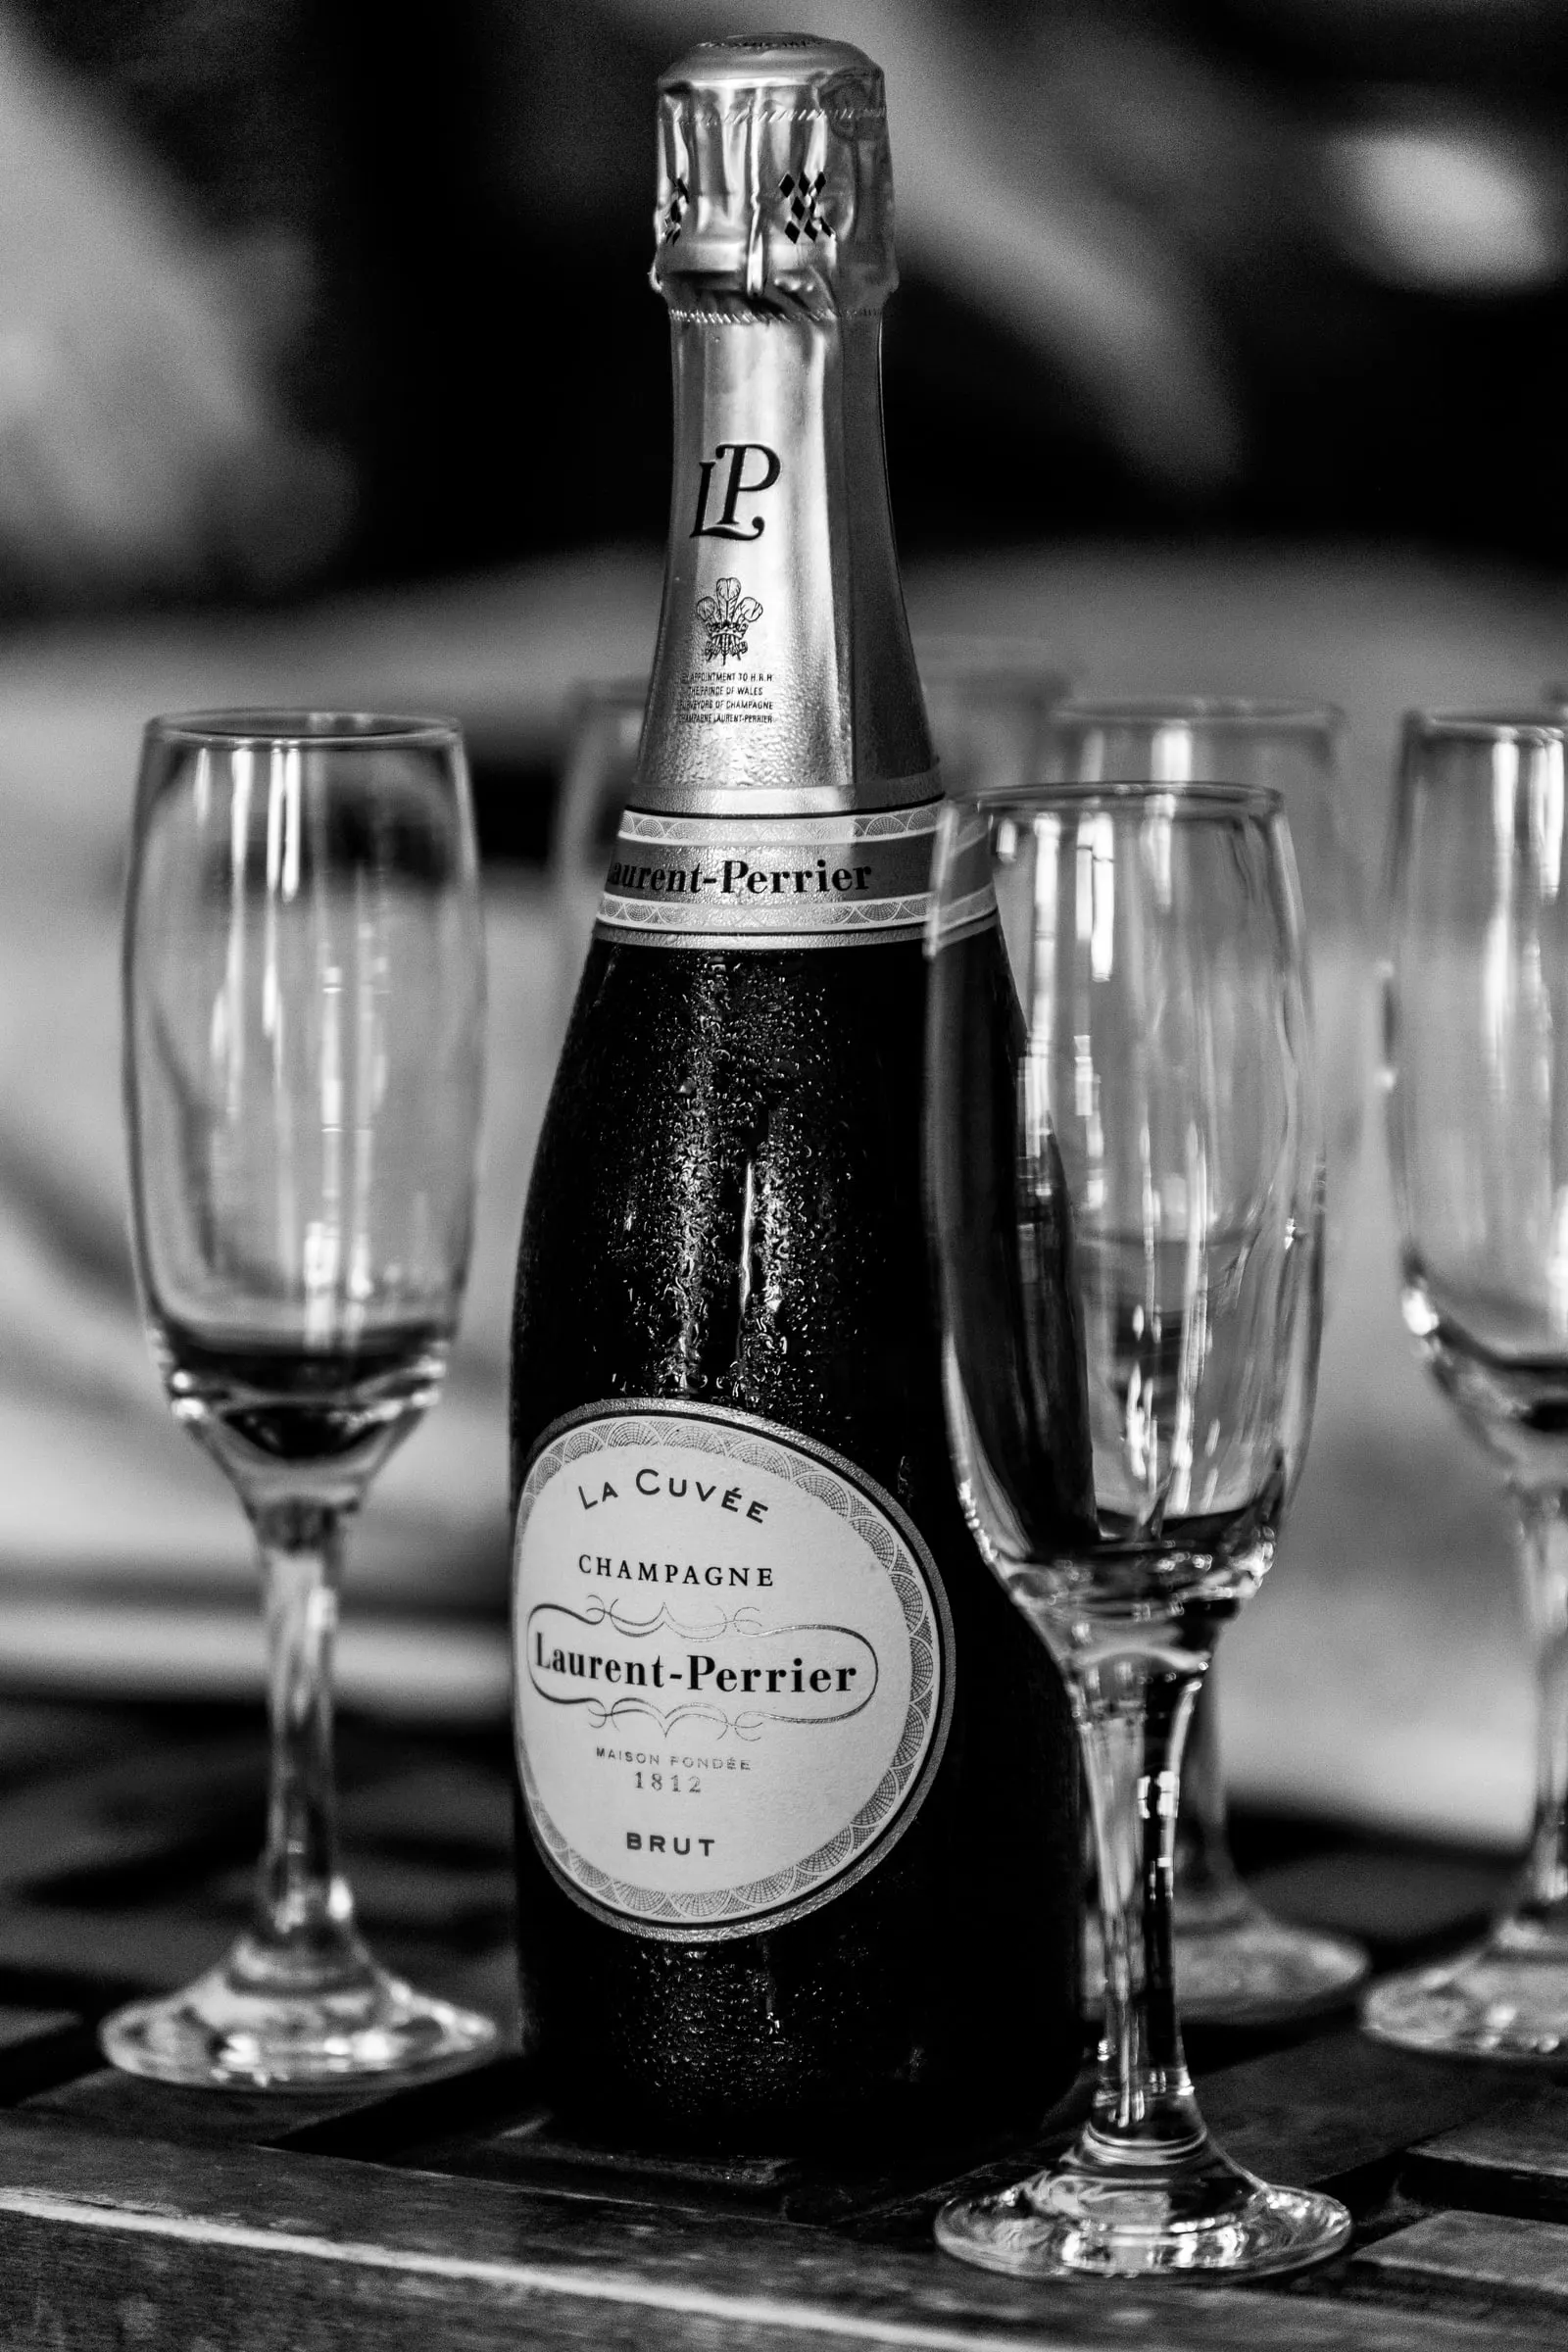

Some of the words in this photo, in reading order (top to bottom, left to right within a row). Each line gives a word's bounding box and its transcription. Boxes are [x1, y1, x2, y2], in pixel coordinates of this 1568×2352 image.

[689, 443, 781, 541] LP
[738, 672, 749, 682] TO
[726, 686, 735, 696] OF
[737, 686, 763, 696] WALES
[715, 700, 724, 710] OF
[726, 700, 773, 710] CHAMPAGNE
[713, 713, 773, 723] LAURENT-PERRIER
[607, 859, 872, 894] aurent-Perrier
[578, 1481, 619, 1510] LA
[636, 1468, 769, 1524] CUVÉE
[578, 1554, 773, 1587] CHAMPAGNE
[536, 1631, 858, 1693] Laurent-Perrier
[596, 1746, 660, 1765] MAISON
[669, 1755, 752, 1771] FONDÉE
[634, 1771, 702, 1793] 1812
[626, 1832, 715, 1857] BRUT
